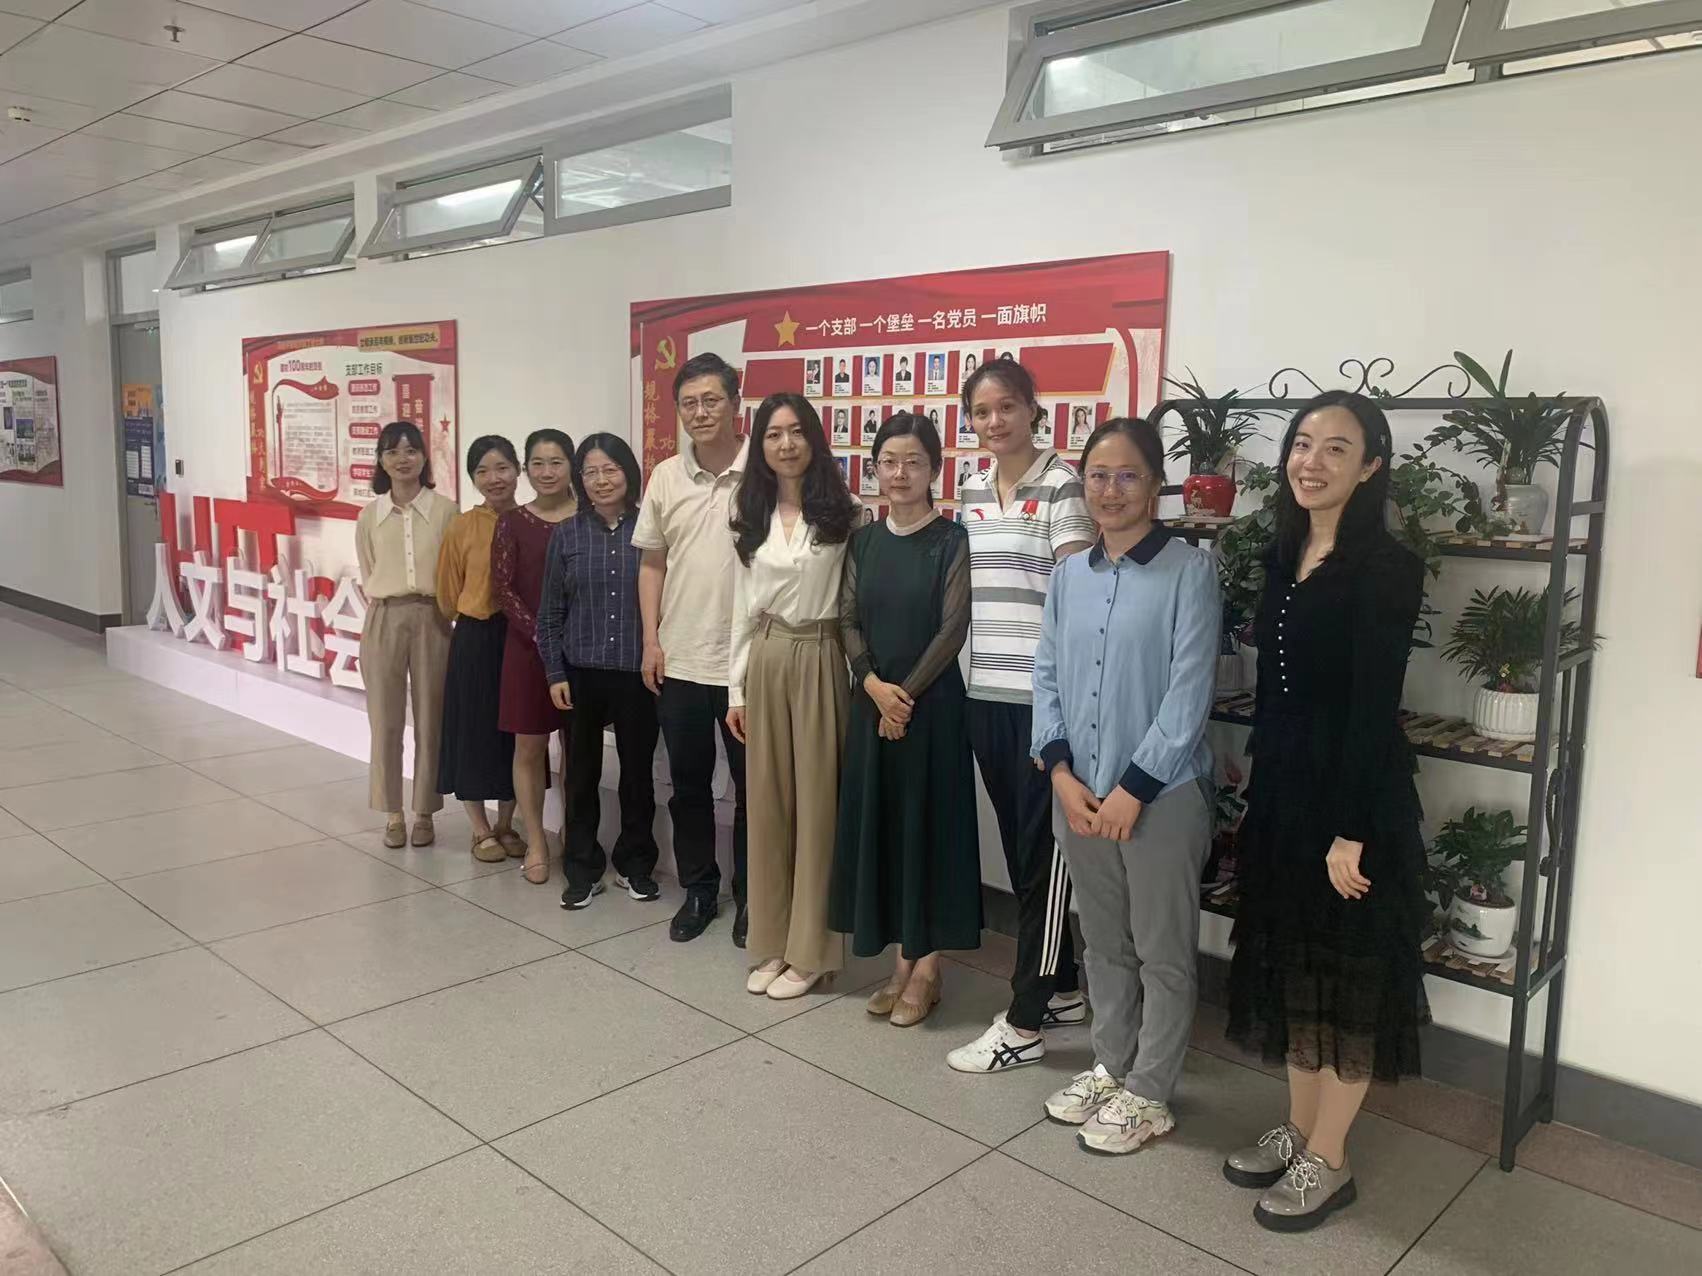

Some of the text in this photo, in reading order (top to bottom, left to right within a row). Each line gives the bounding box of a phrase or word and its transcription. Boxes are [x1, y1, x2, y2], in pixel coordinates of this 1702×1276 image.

[805, 302, 1047, 337] 一个支部 一个堡垒 一名党员 一面旗帜
[146, 543, 367, 691] 人文与社会
